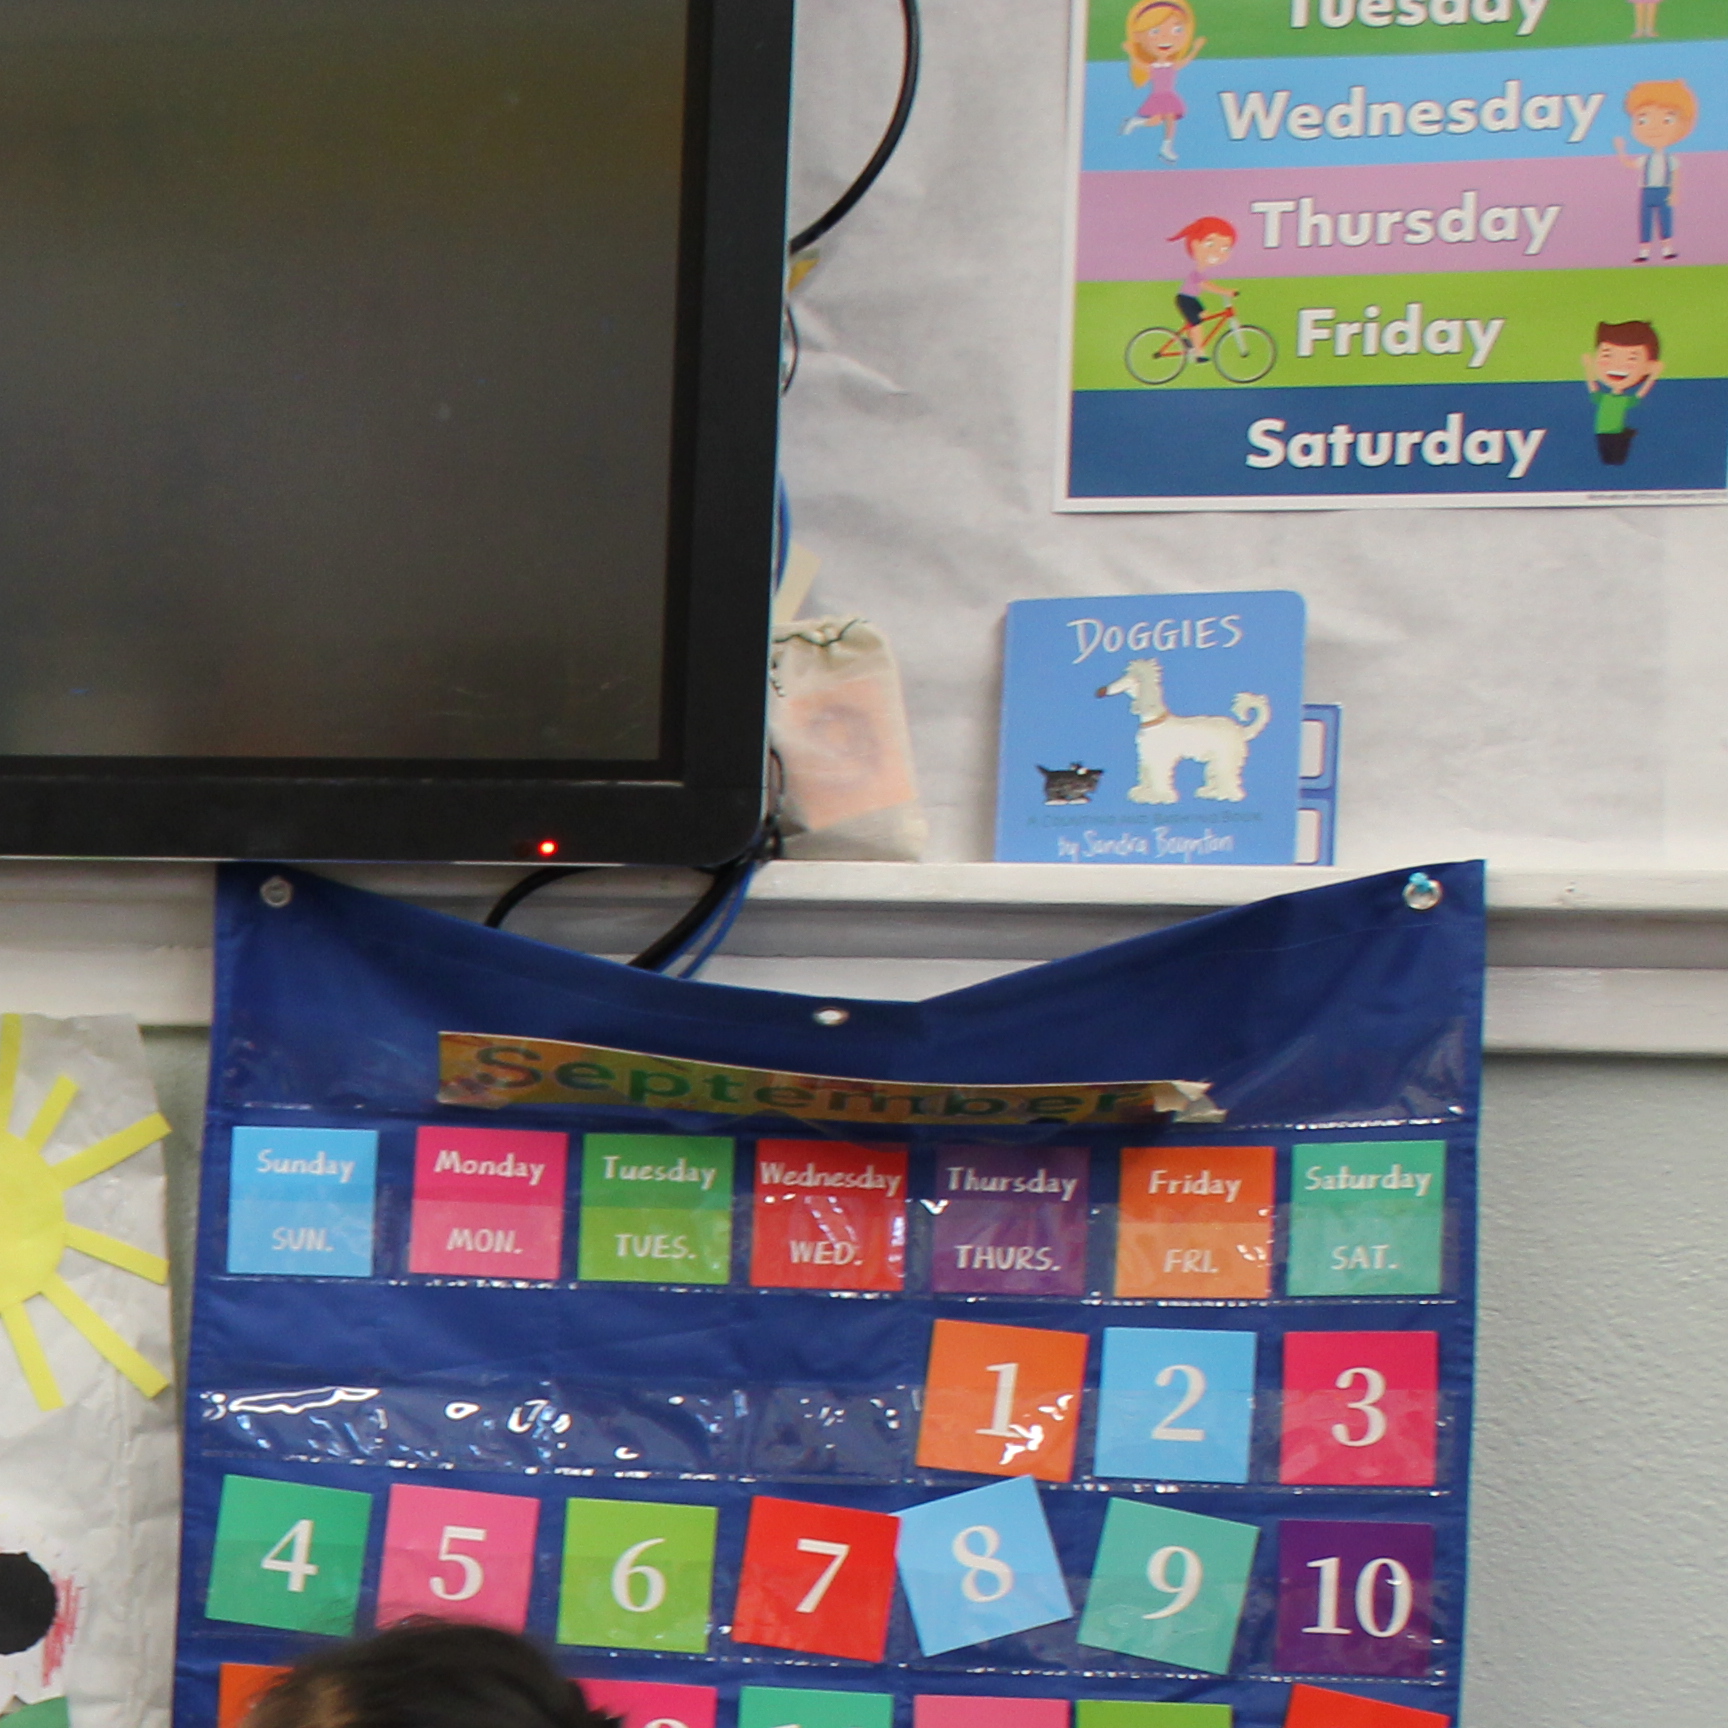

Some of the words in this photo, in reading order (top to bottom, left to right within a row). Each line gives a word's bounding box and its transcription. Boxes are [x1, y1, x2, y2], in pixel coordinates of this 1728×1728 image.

[1219, 80, 1605, 143] Wednesday
[1251, 191, 1562, 256] Thursday
[1296, 302, 1505, 368] Friday
[1246, 412, 1547, 479] Saturday
[1066, 614, 1245, 664] DOGGIES
[475, 1045, 1148, 1117] September
[257, 1149, 355, 1184] Sunday
[434, 1150, 546, 1186] Monday
[602, 1155, 718, 1190] Tuesday
[760, 1161, 902, 1197] Wednesday
[947, 1167, 1079, 1201] Thursday
[1148, 1170, 1242, 1203] Friday
[1305, 1164, 1433, 1197] Saturday
[272, 1227, 334, 1253] SUN.
[446, 1227, 523, 1255] MON.
[614, 1233, 696, 1260] TUES.
[789, 1240, 864, 1266] WED.
[954, 1245, 1062, 1272] THURS.
[1330, 1244, 1399, 1270] SAT.
[975, 1362, 1028, 1439] 1
[1151, 1364, 1207, 1441] 2
[1331, 1367, 1388, 1447] 3
[260, 1518, 319, 1593] 4
[428, 1525, 487, 1600] 5
[611, 1537, 666, 1612] 6
[795, 1538, 850, 1613] 7
[952, 1525, 1013, 1602] 8
[1142, 1545, 1204, 1620] 9
[1301, 1556, 1414, 1638] 10
